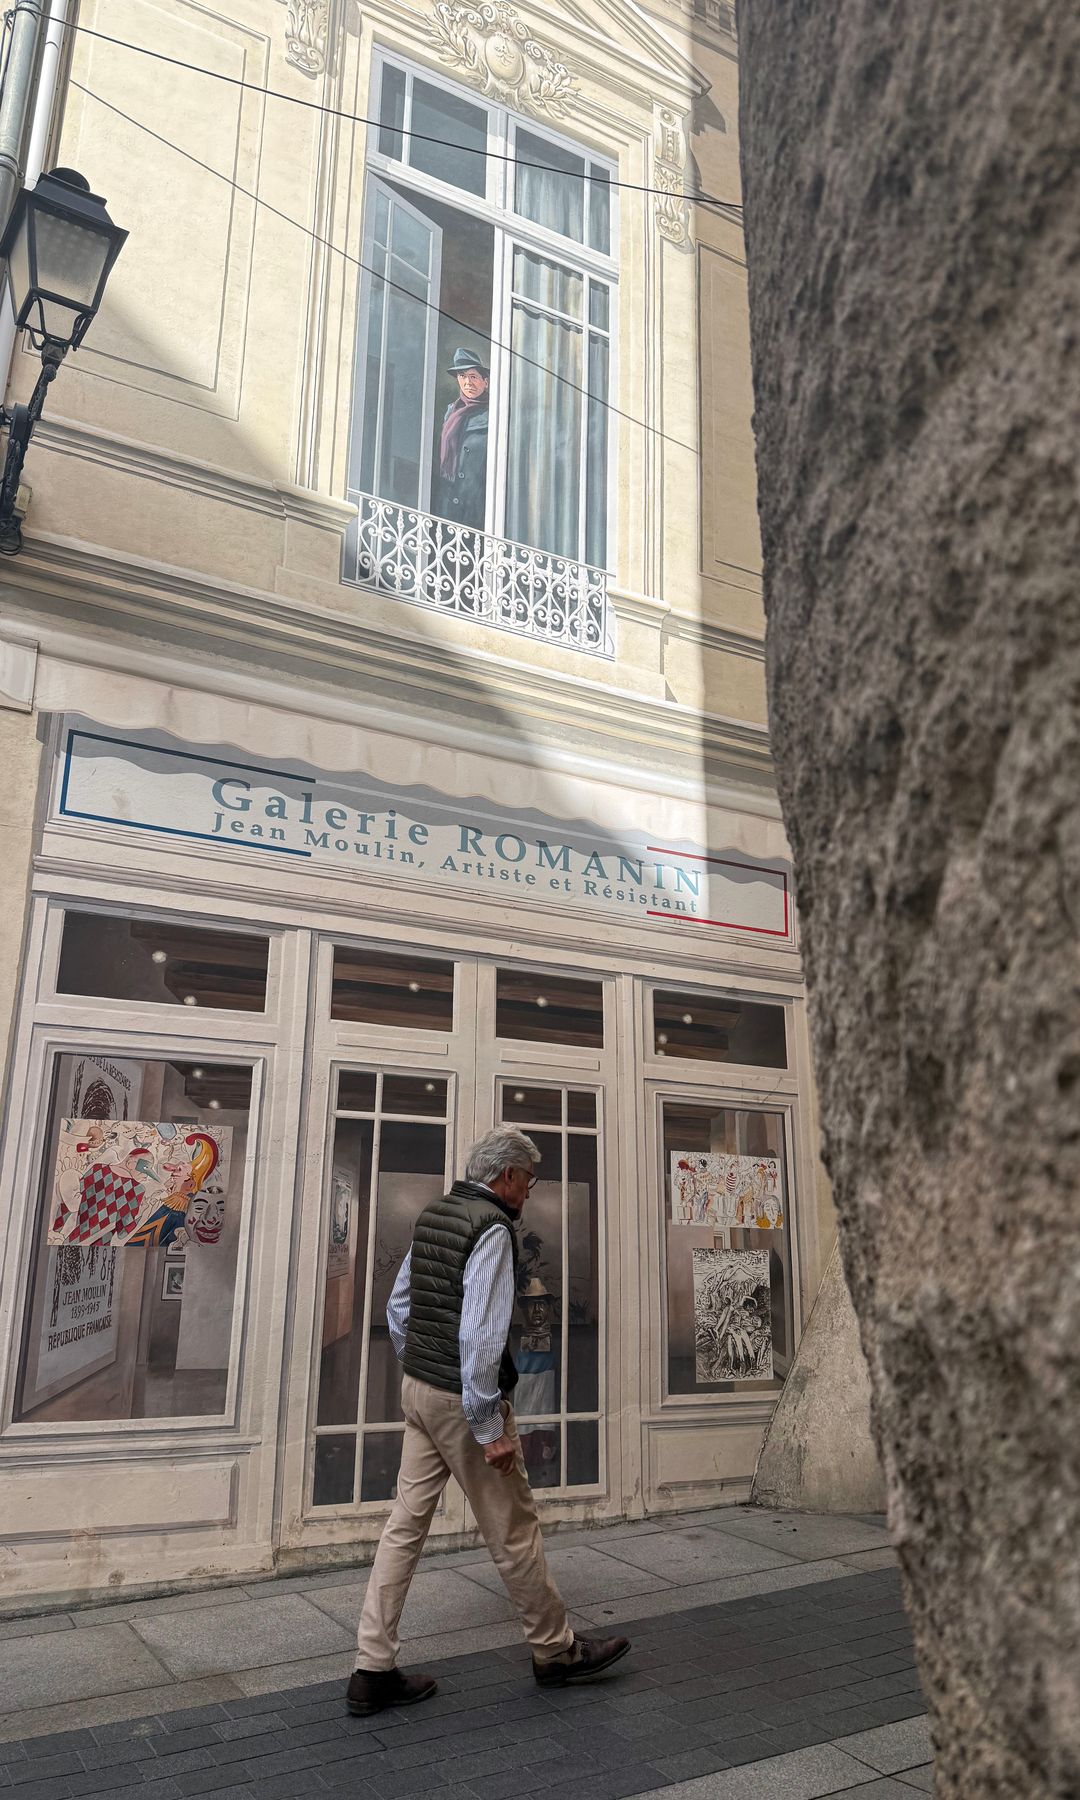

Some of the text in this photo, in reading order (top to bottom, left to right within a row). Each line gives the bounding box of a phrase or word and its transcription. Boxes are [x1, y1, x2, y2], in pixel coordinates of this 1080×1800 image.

[211, 777, 701, 897] Galerie ROMANIN
[211, 812, 698, 913] Jean Moulin, Artiste et Résistant
[62, 1284, 107, 1306] JEAN MOULIN
